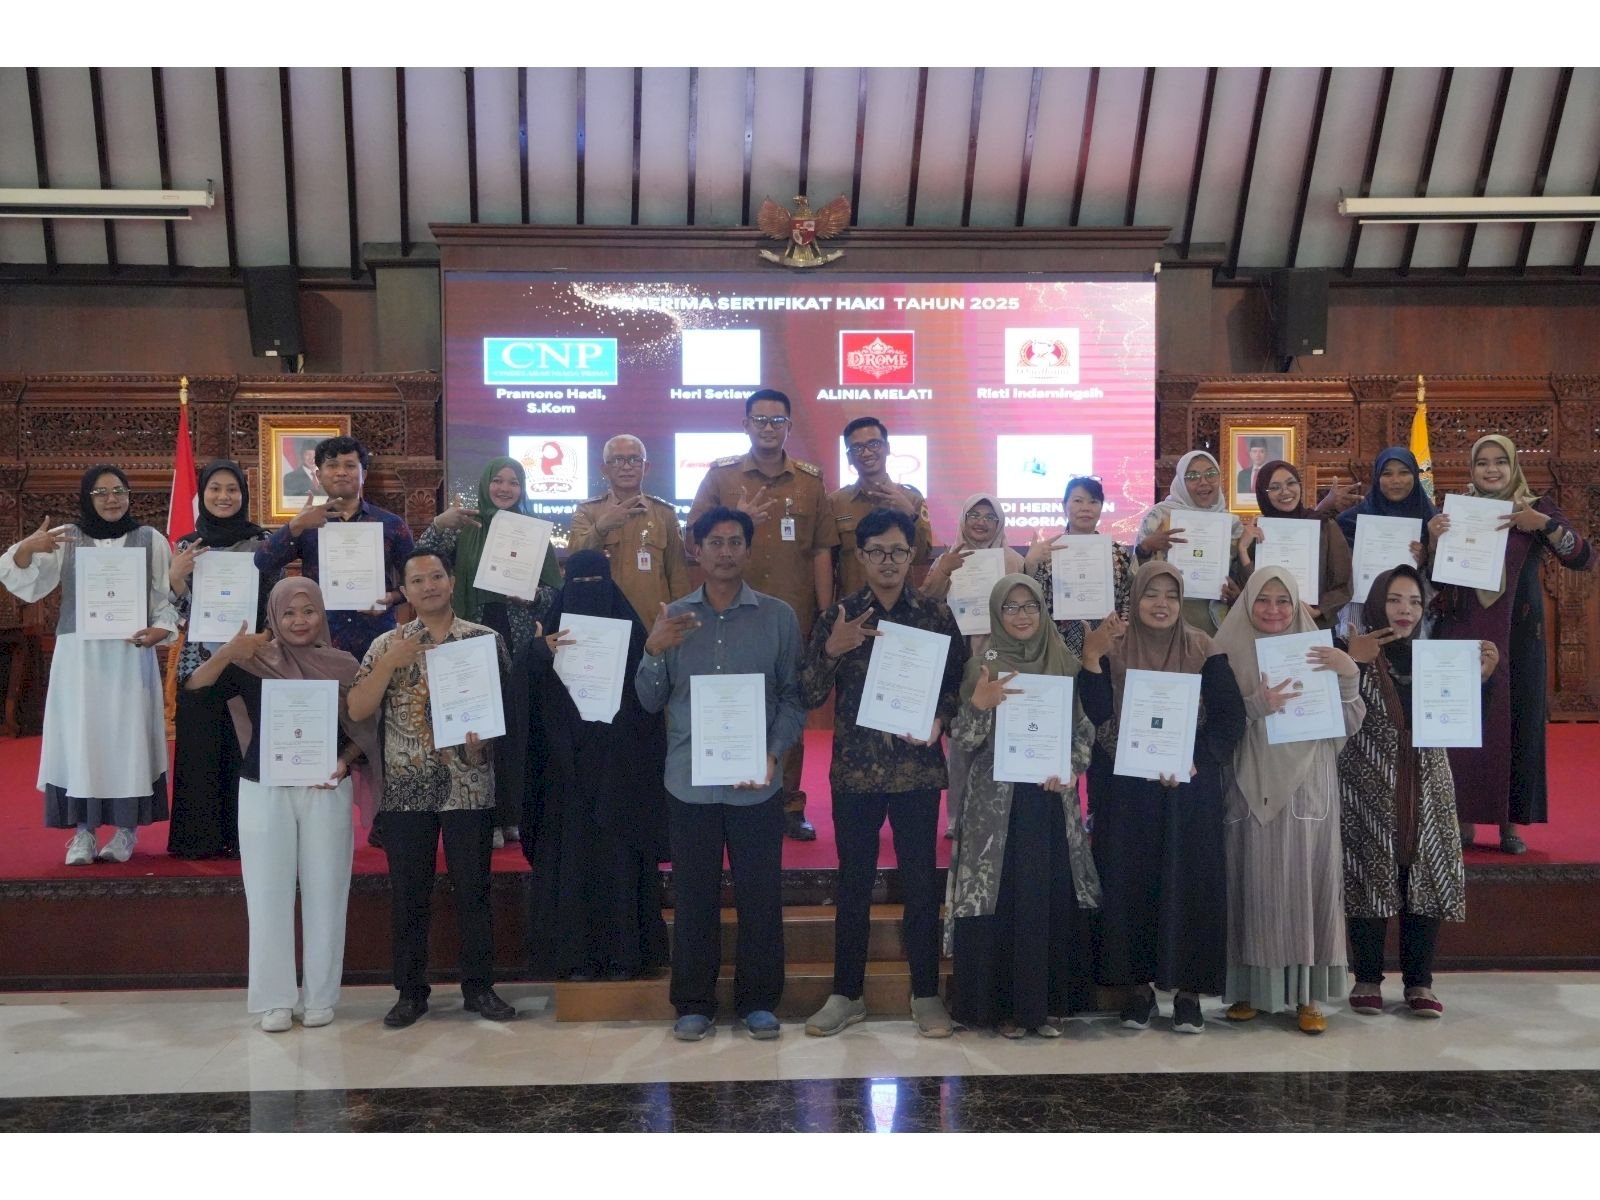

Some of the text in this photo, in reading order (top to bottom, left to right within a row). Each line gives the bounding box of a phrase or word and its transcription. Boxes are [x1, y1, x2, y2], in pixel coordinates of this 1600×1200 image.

[718, 297, 832, 310] SERTIFIKAT
[836, 297, 885, 310] HAKI
[893, 297, 965, 310] TAHUN
[969, 297, 1020, 310] 2025
[502, 342, 603, 369] CNP
[496, 388, 607, 401] Pramono Hadi,
[670, 388, 756, 400] Heri Setiaw
[816, 388, 933, 400] ALINIA MELATI
[977, 387, 1010, 399] Risti
[526, 402, 576, 413] S.Kom
